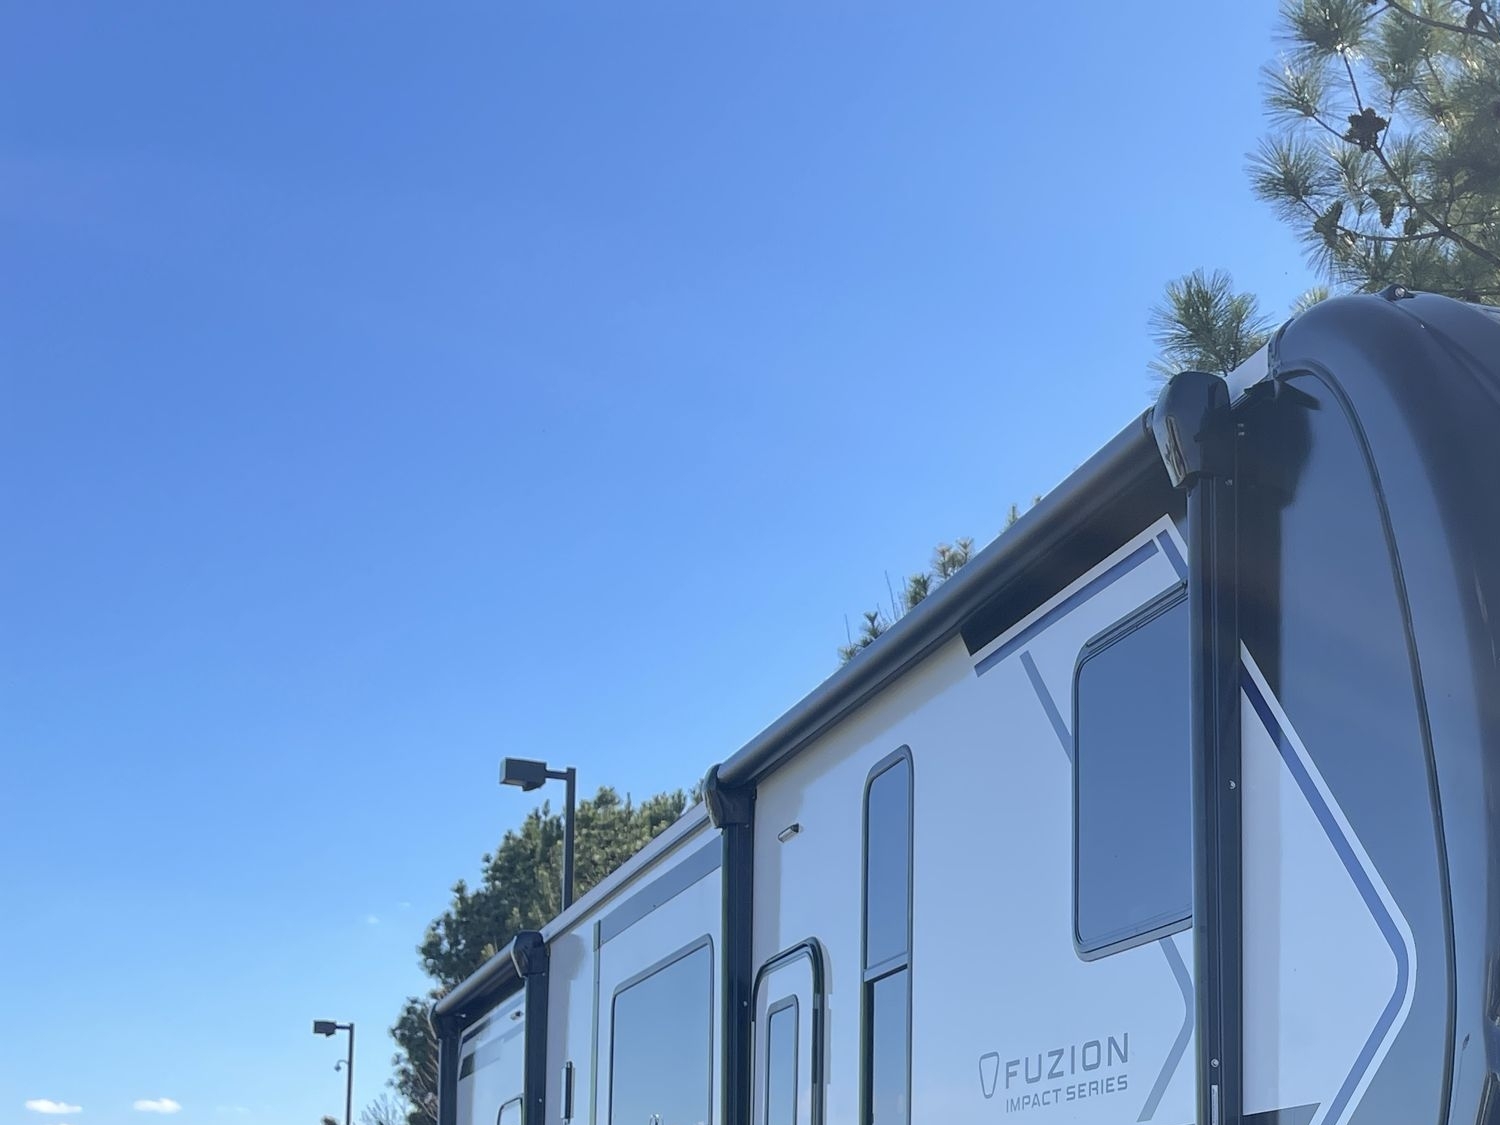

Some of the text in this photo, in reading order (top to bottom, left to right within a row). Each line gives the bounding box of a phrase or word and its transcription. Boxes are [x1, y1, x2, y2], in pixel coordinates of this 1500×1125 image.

[1006, 1032, 1128, 1089] FUZION
[1006, 1074, 1128, 1113] IMPACT SERIES
